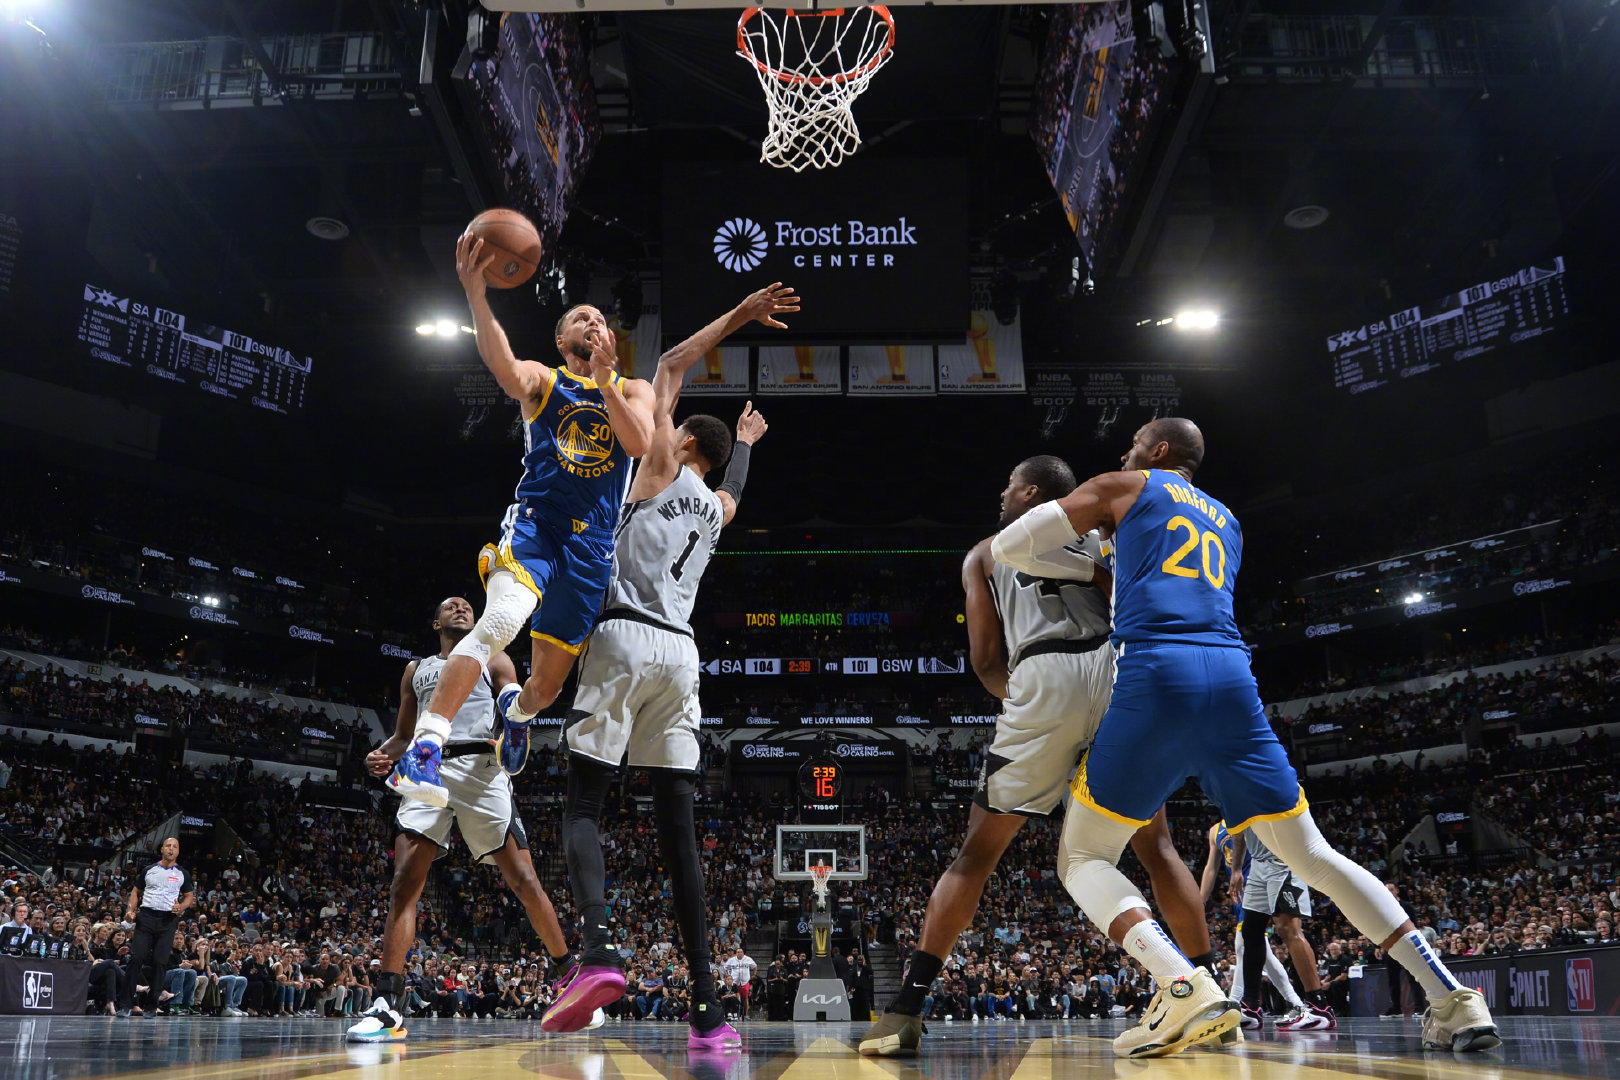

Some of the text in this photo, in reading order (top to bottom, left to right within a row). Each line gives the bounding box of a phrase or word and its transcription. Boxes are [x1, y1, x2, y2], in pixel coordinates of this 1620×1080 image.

[774, 217, 918, 247] Frost Bank
[793, 253, 895, 268] CENTER
[1465, 274, 1519, 303] 101 GSW
[132, 303, 181, 329] SA 104
[1369, 310, 1416, 335] SA 104
[229, 334, 277, 358] 101 GSW
[1040, 373, 1072, 382] NBA
[1093, 372, 1125, 382] NBA
[1144, 373, 1177, 383] NBA
[997, 382, 1022, 390] SPURS
[459, 397, 497, 406] 1999
[1032, 396, 1075, 406] 2007
[1086, 396, 1131, 406] 2013
[1138, 397, 1180, 407] 2014
[557, 400, 595, 416] GOLDEN
[588, 422, 611, 442] 30
[557, 450, 616, 479] WARRIORS
[1162, 482, 1227, 530] HORFORD
[669, 529, 701, 583] 1
[1161, 515, 1226, 590] 20
[94, 593, 121, 604] CASINO
[201, 613, 227, 624] CASINO
[745, 612, 891, 627] TACOS MARGARITAS CERVEZA
[299, 633, 322, 643] CASINO
[390, 650, 412, 660] CASINO
[721, 659, 914, 674] SA 104 2:39 4TH 101 GSW
[801, 716, 874, 725] WE LOVE WINNERS!
[950, 715, 964, 724] WE
[964, 715, 985, 724] LOVE
[755, 751, 785, 759] CASINO
[850, 750, 879, 758] CASINO
[813, 766, 836, 778] 2:39
[816, 777, 834, 797] 16
[1509, 966, 1550, 1008] 5PM ET
[1577, 968, 1590, 1001] TV
[802, 993, 842, 1006] KIA
